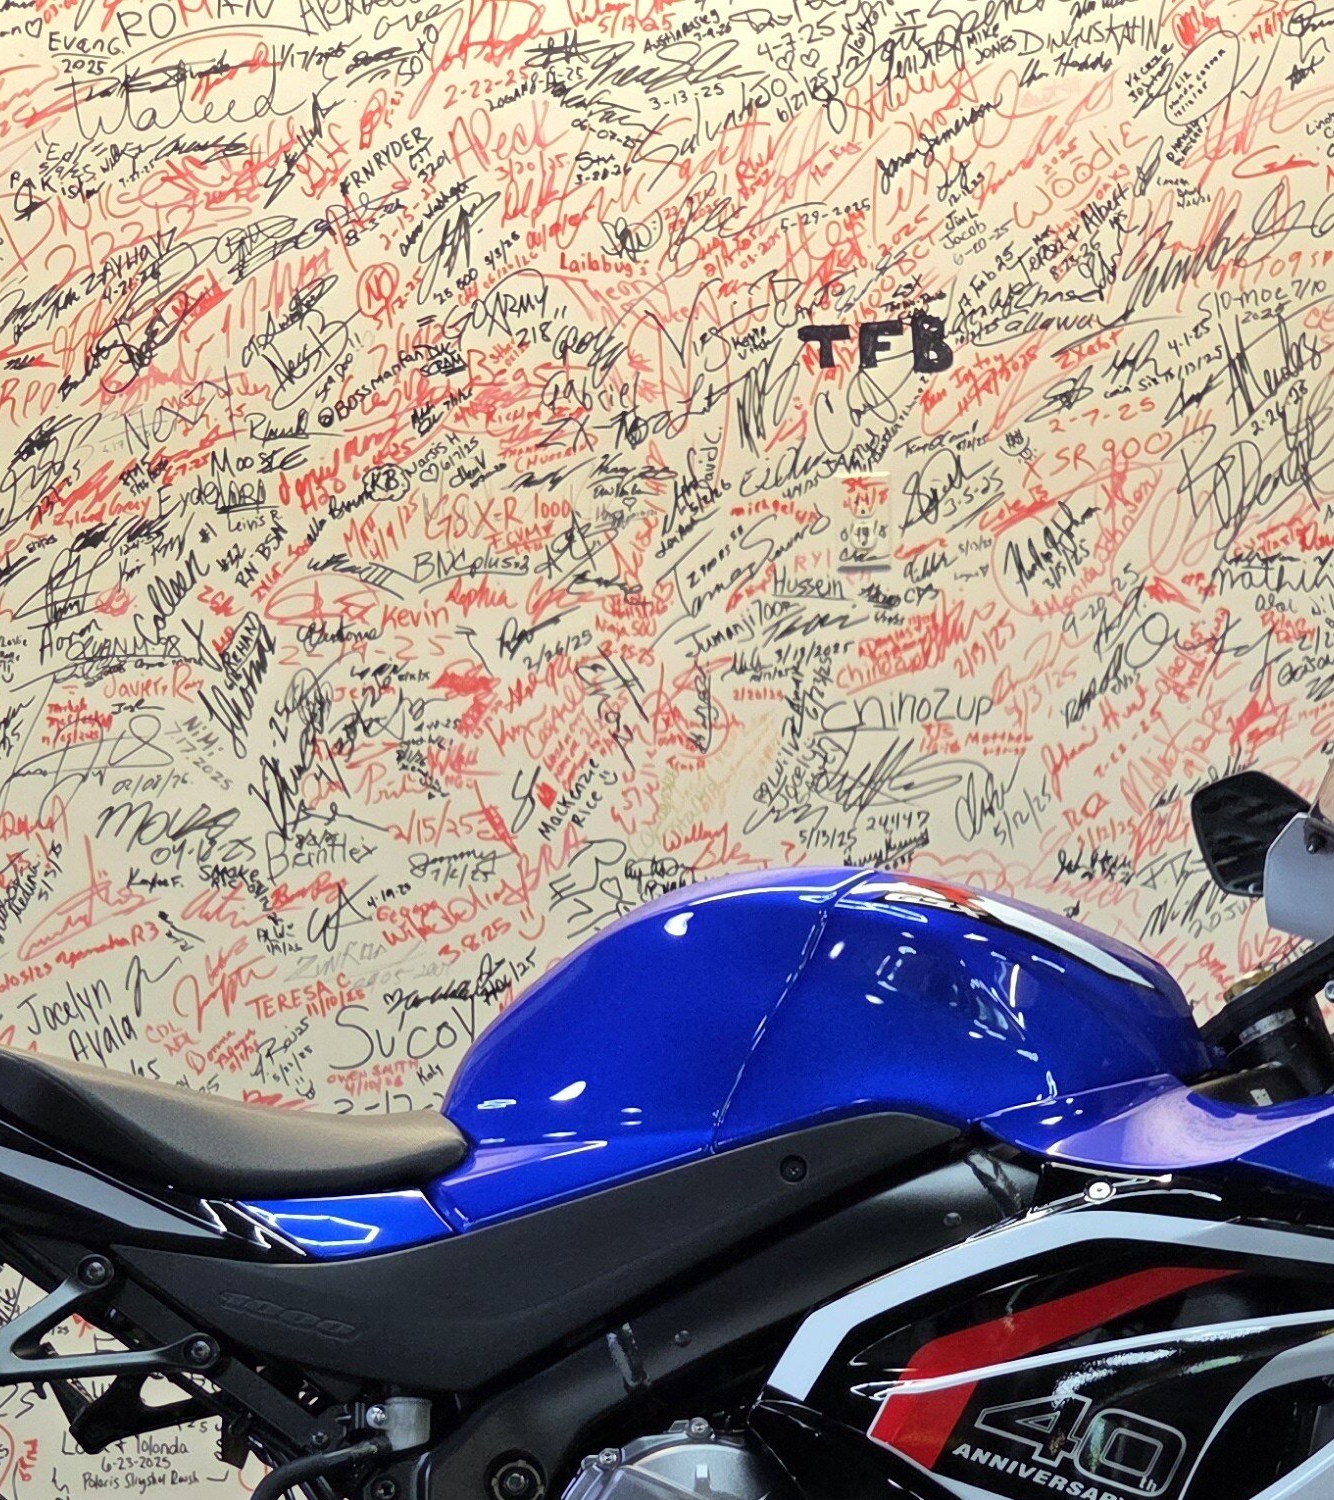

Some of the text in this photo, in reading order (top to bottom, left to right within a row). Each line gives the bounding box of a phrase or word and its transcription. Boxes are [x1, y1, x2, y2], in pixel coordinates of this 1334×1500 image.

[60, 56, 110, 75] 2025
[648, 83, 726, 111] 3-13-25
[797, 315, 954, 374] TFB
